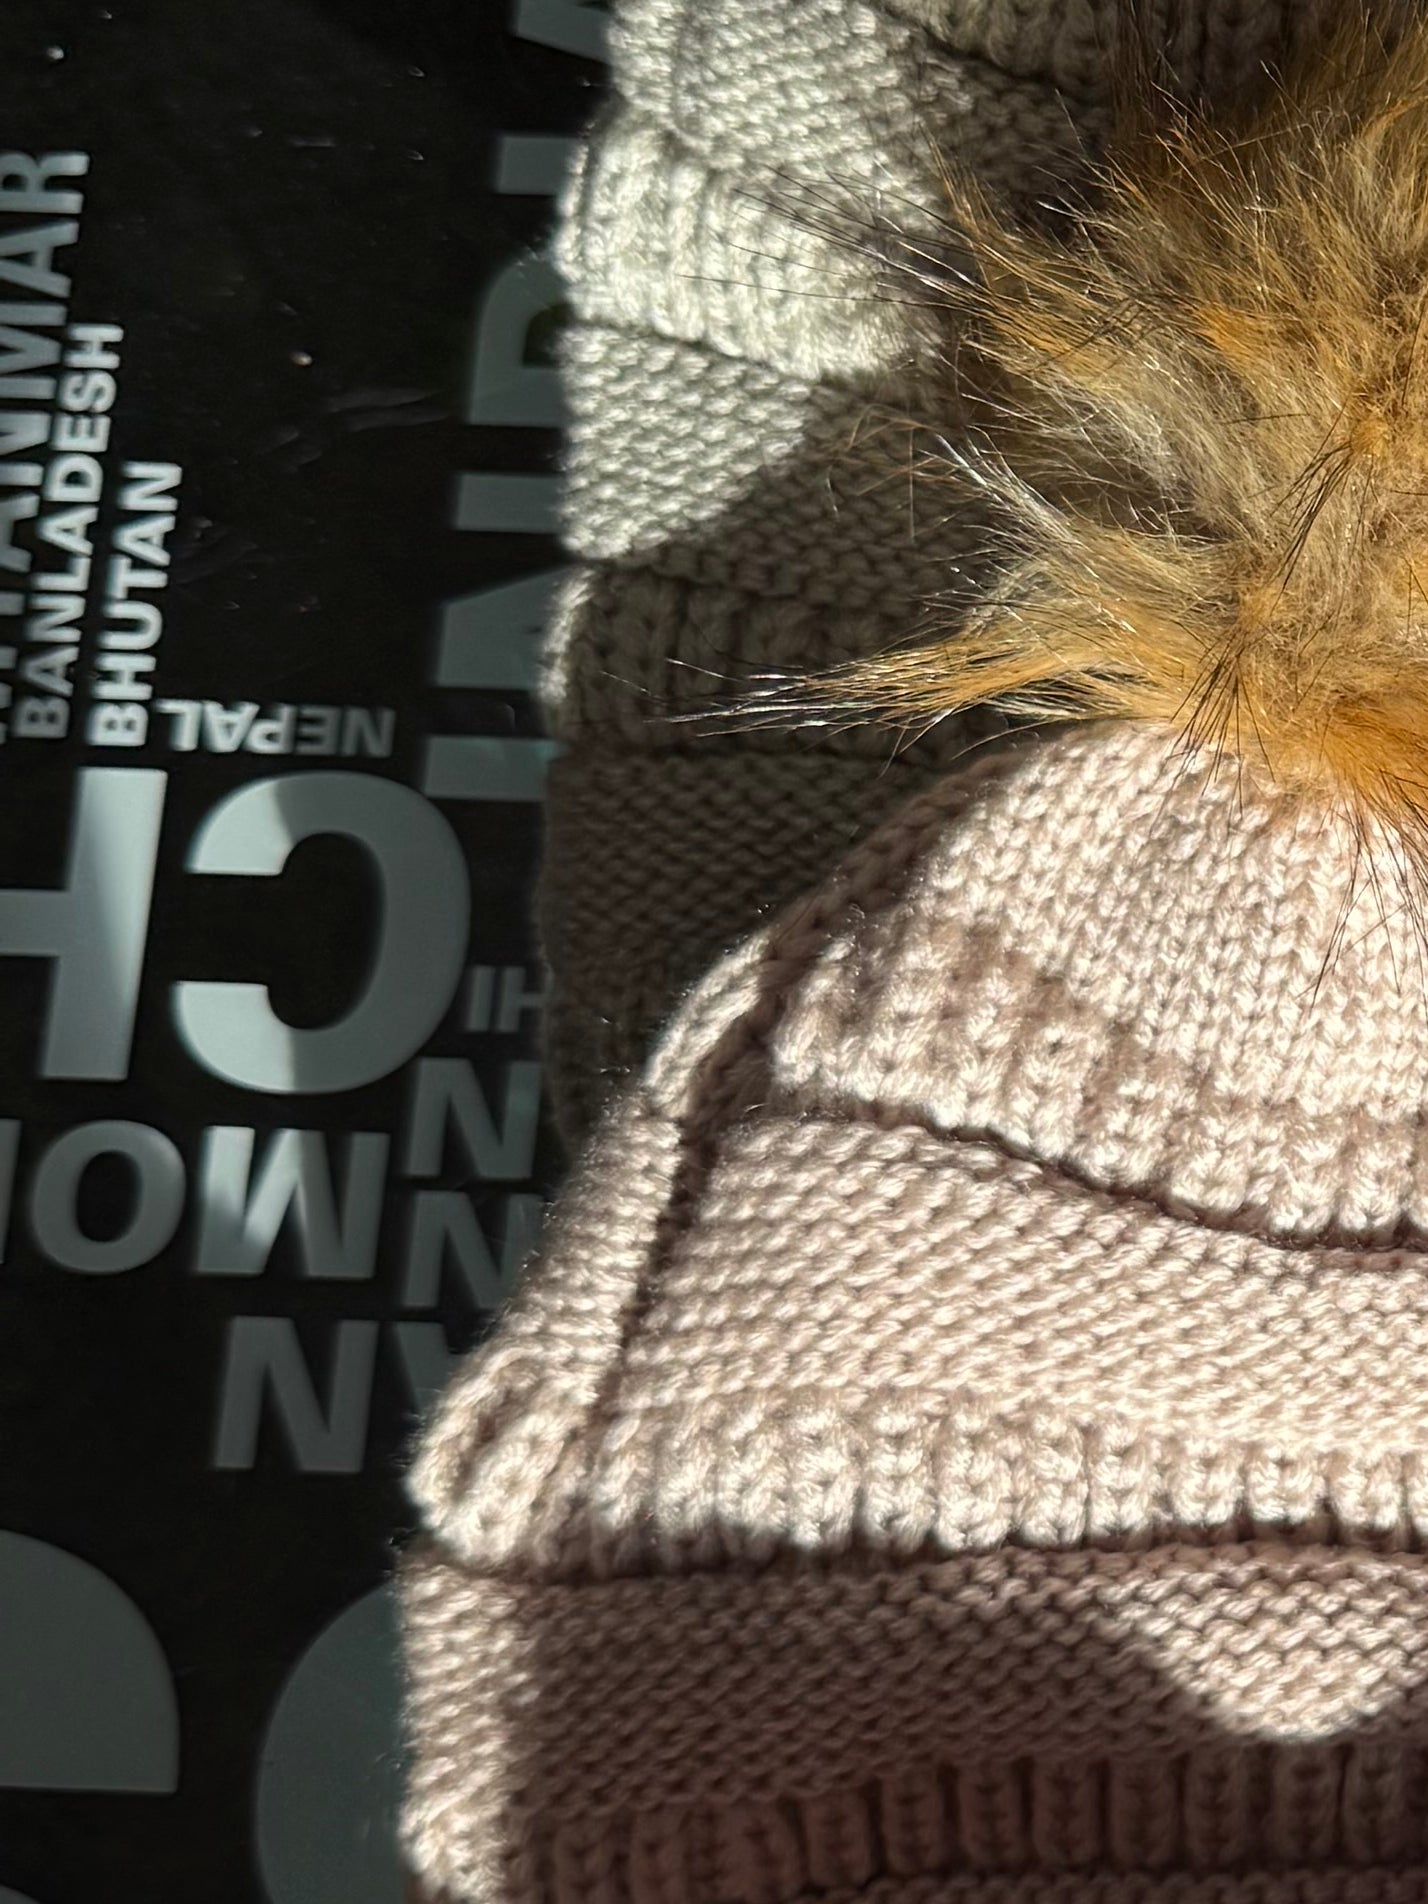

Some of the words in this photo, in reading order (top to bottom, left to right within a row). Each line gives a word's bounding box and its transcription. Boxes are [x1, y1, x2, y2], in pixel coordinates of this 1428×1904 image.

[13, 322, 125, 741] BANLADESH
[86, 459, 183, 749] BHUTAN
[155, 697, 396, 758] NEPAL
